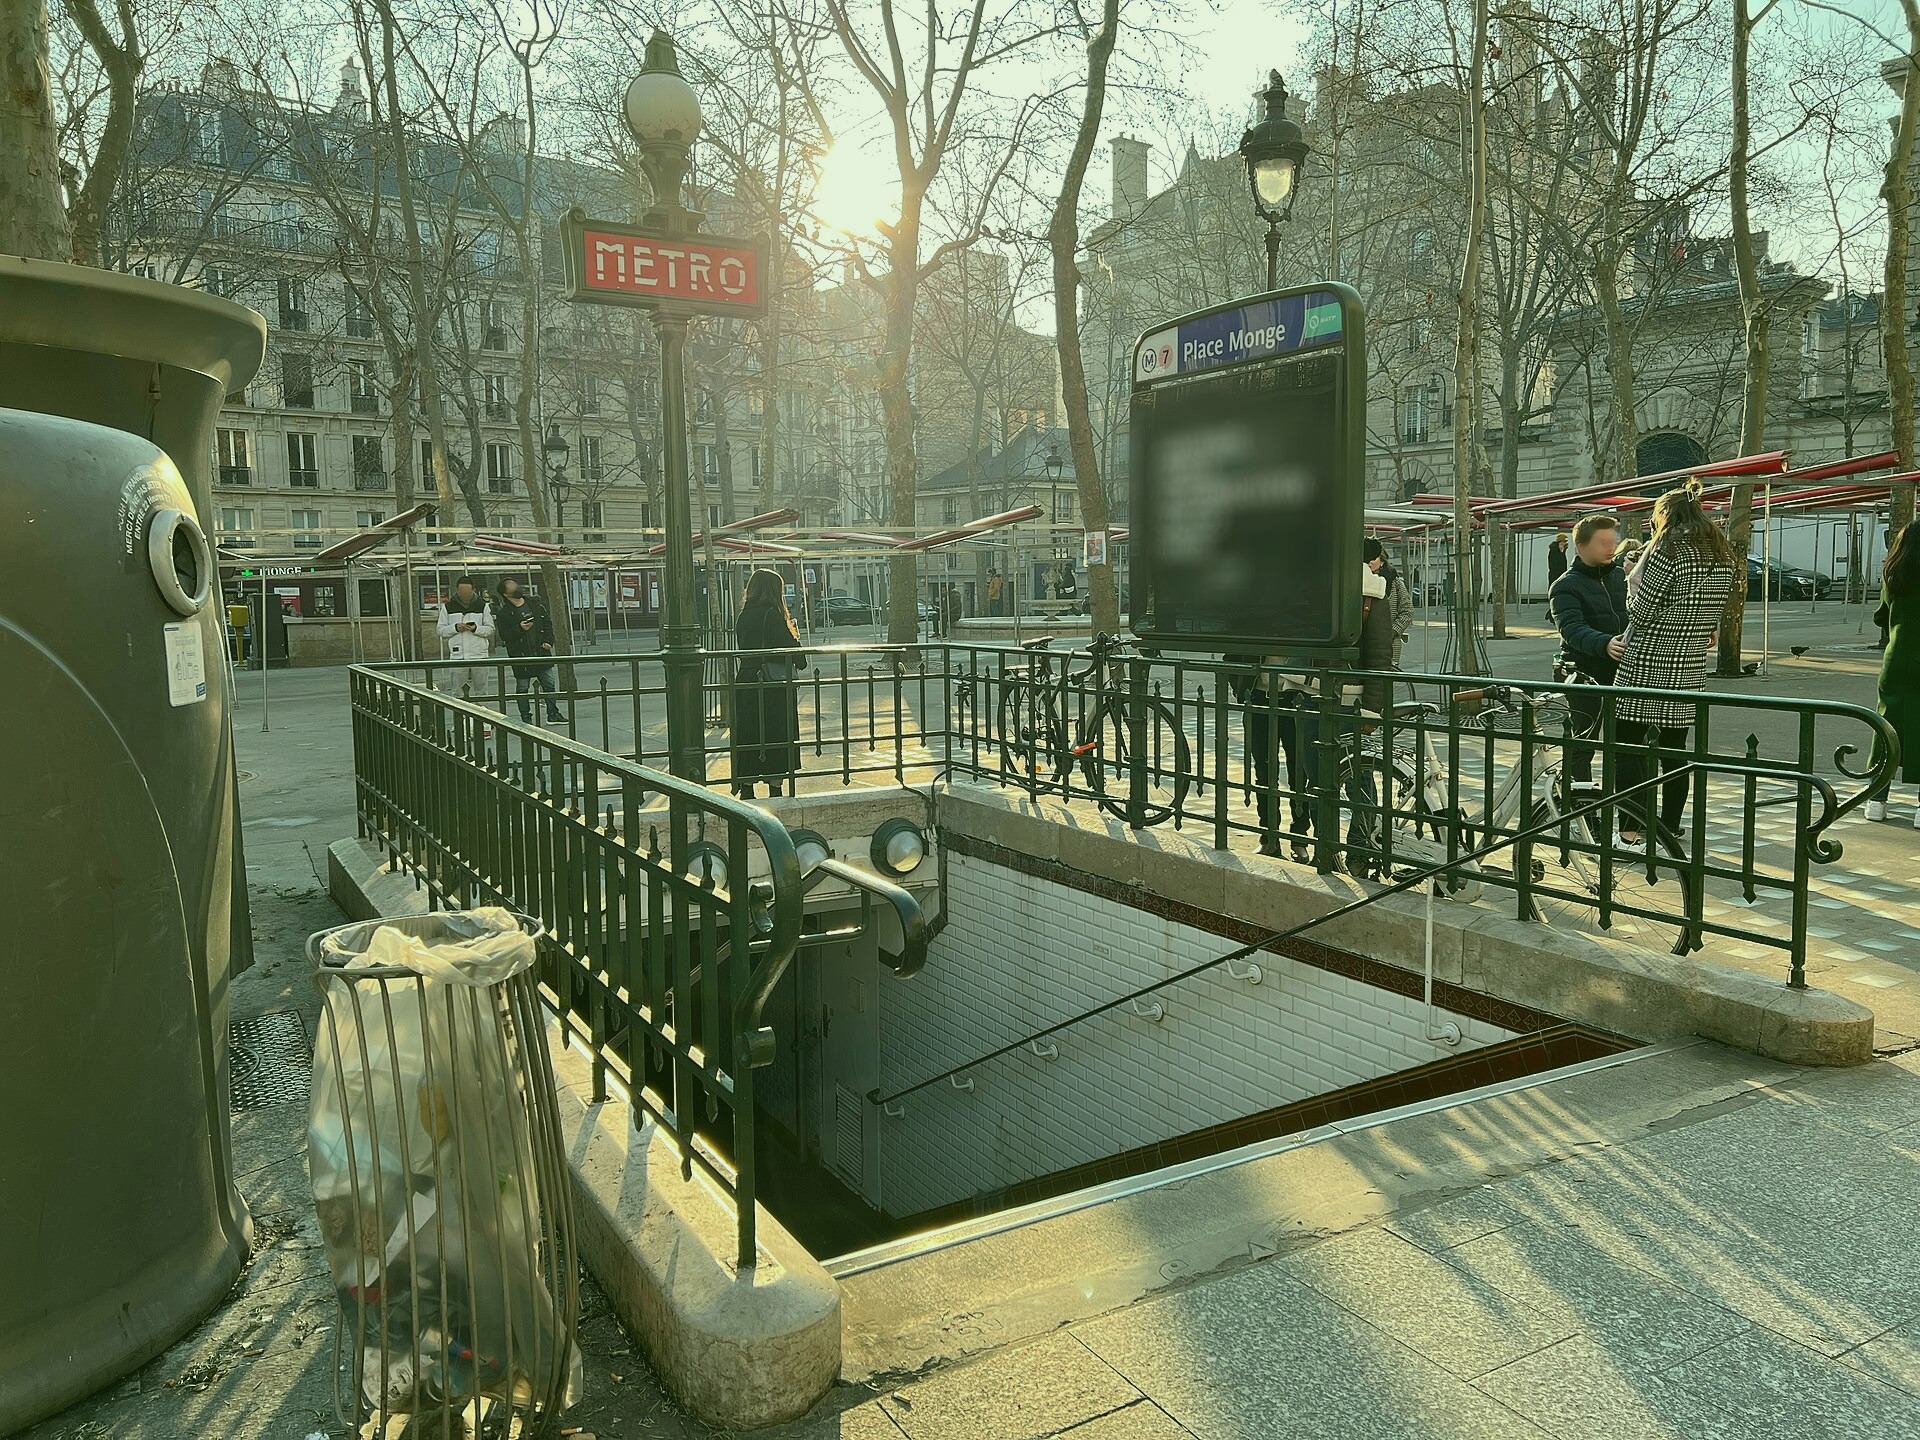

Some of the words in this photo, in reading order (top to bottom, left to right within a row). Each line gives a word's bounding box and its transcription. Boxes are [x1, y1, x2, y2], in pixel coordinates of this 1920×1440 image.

[594, 240, 746, 295] METRO
[1183, 336, 1224, 362] Place
[1228, 323, 1286, 352] Monge
[1162, 349, 1169, 364] 7
[132, 494, 142, 508] NE
[136, 483, 149, 499] PAS
[127, 506, 137, 521] DE
[134, 507, 147, 541] ENTRE
[125, 519, 134, 555] MERCI
